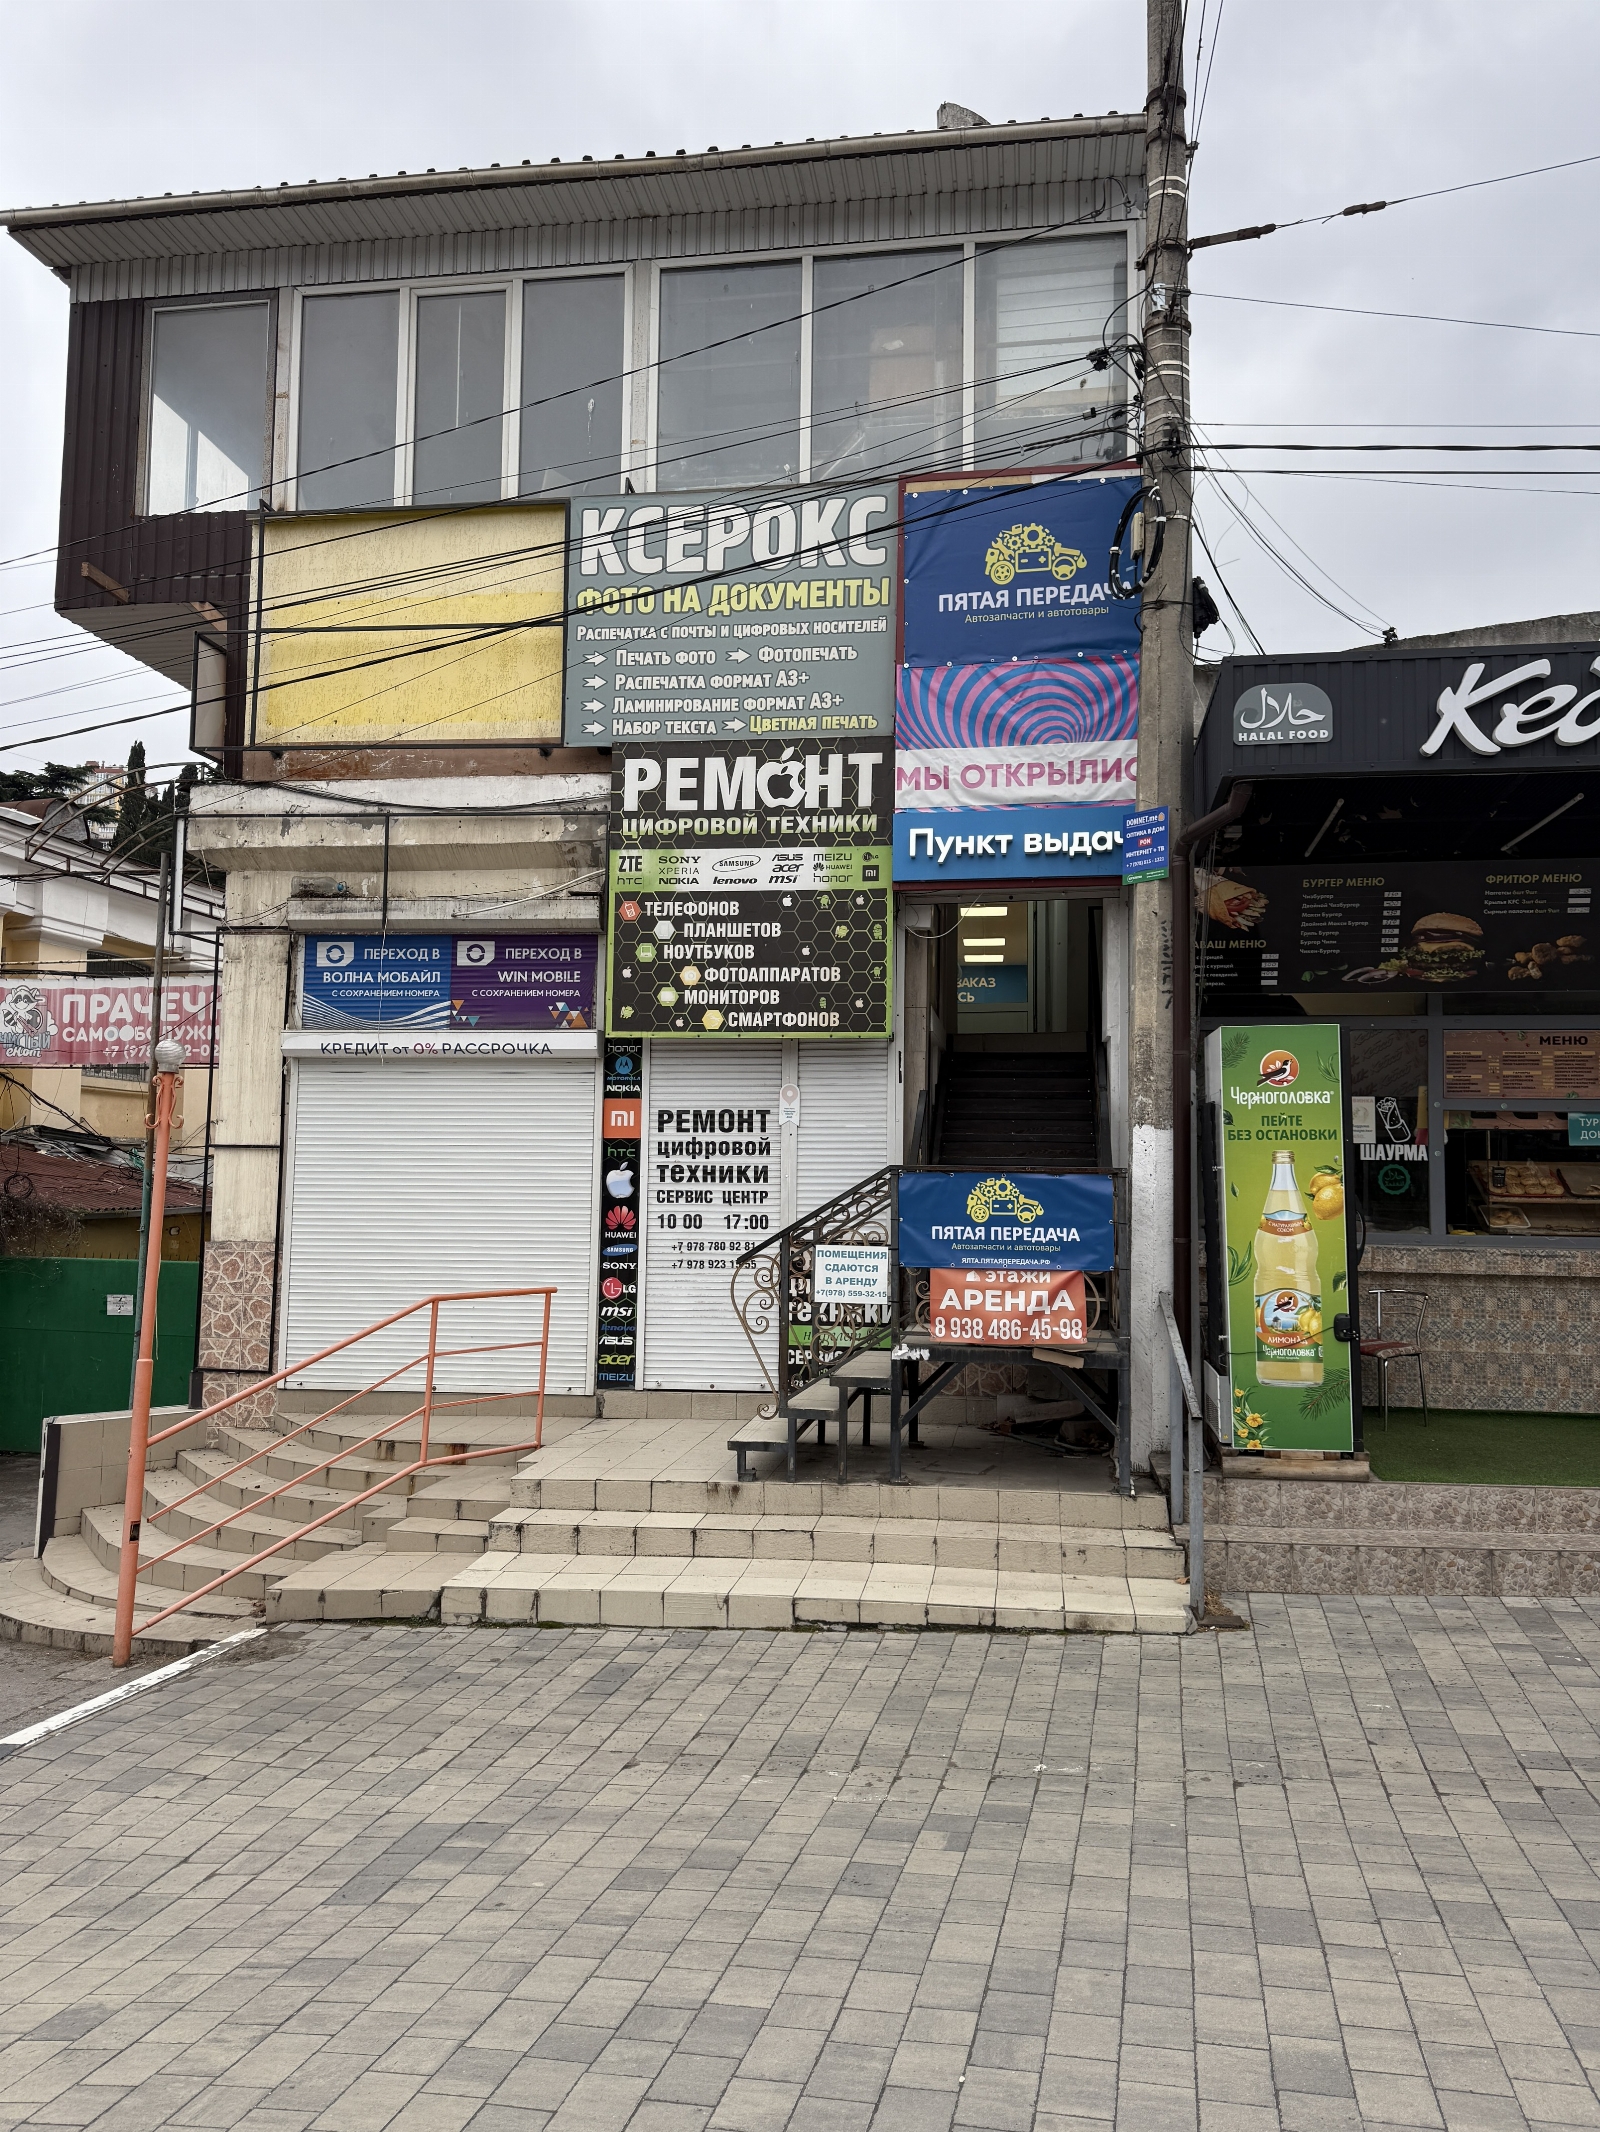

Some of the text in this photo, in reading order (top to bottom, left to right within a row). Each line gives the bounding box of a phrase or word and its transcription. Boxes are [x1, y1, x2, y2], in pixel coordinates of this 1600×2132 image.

[580, 496, 887, 575] КСЕРОКС
[577, 577, 889, 616] ФОТО НА ДОКУМЕНТЫ
[938, 589, 1009, 613] ПЯТАЯ
[965, 605, 1109, 623] Автозапчасти и автотовары
[577, 625, 657, 641] РАСПЕЧАТКА
[672, 625, 717, 638] ПОЧТЫ
[720, 625, 729, 637] И
[733, 621, 809, 639] ЦИФРОВЫХ
[813, 616, 887, 634] НОСИТЕЛЕЙ
[616, 645, 858, 666] ПЕЧАТЬ ФОТО ФОТОПЕЧАТЬ
[614, 673, 706, 691] РАСПЕЧАТКА
[710, 673, 771, 689] ФОРМАТ
[612, 697, 739, 714] ЛАМИНИРОВАНИЕ
[743, 696, 805, 712] ФОРМАТ
[1239, 688, 1326, 729] حلال
[612, 718, 717, 735] НАБОР ТЕКСТА
[749, 715, 879, 735] ЦВЕТНАЯ ПЕЧАТЬ
[1238, 728, 1330, 742] HALAL FOOD
[623, 751, 884, 812] РЕМОНТ
[896, 764, 950, 792] МЫ
[621, 813, 878, 838] ЦИФРОВОЙ ТЕХНИКИ
[910, 826, 1013, 864] Пункт
[658, 855, 702, 865] SONY
[719, 858, 754, 868] SAMSUNG
[771, 853, 804, 862] ASUS
[813, 852, 852, 862] MEIZU
[618, 855, 643, 873] ZTE
[772, 863, 803, 873] acer
[825, 863, 853, 871] HUAWEI
[658, 866, 700, 876] XPERIA
[813, 872, 853, 883] honor
[616, 875, 643, 886] htc
[658, 876, 700, 885] NOKIA
[712, 875, 758, 885] lenovo
[768, 875, 800, 884] msi
[1302, 877, 1385, 889] БУРГЕР МЕНЮ
[1485, 873, 1582, 884] ФРИТЮР МЕНЮ
[644, 900, 740, 917] ТЕЛЕФОНОВ
[683, 922, 782, 938] ПЛАНШЕТОВ
[1229, 939, 1267, 949] МЕНЮ
[364, 947, 440, 962] ПЕРЕХОД В
[505, 947, 582, 962] ПЕРЕХОД В
[663, 944, 755, 960] НОУТБУКОВ
[323, 968, 441, 984] ВОЛНА МОБАЙЛ
[497, 970, 581, 983] WIN MOBILE
[704, 966, 841, 983] ФОТОАППАРАТОВ
[339, 989, 405, 997] СОХРАНЕНИЕМ
[405, 989, 440, 997] НОМЕРА
[480, 989, 545, 997] СОХРАНЕНИЕМ
[545, 989, 581, 997] НОМЕРА
[683, 989, 780, 1005] МОНИТОРОВ
[957, 991, 975, 1003] СЬ
[727, 1011, 841, 1028] СМАРТФОНОВ
[1539, 1035, 1588, 1046] МЕНЮ
[320, 1042, 553, 1056] КРЕДИТ от 0% РАССРОЧКА
[608, 1043, 641, 1053] honor
[606, 1084, 641, 1092] NOKIA
[657, 1109, 771, 1134] РЕМОНТ
[1261, 1112, 1303, 1126] ПЕЙТЕ
[1227, 1129, 1337, 1141] БЕЗ ОСТАНОВКИ
[608, 1147, 636, 1157] htc
[657, 1136, 771, 1161] цифровой
[1359, 1143, 1429, 1161] ШАУРМА
[656, 1163, 769, 1184] техники
[656, 1189, 769, 1207] СЕРВИС ЦЕНТР
[657, 1213, 678, 1229] 10
[682, 1213, 703, 1229] 00
[605, 1231, 637, 1239] HUAWEI
[931, 1225, 1080, 1244] ПЯТАЯ ПЕРЕДАЧА
[671, 1241, 756, 1251] +7 978 780 92 81
[951, 1241, 1002, 1252] Автозапчасти
[1014, 1243, 1061, 1253] автотовары
[817, 1249, 888, 1261] ПОМЕЩЕНИЯ
[602, 1262, 637, 1270] SONY
[671, 1260, 684, 1269] +7
[687, 1260, 705, 1269] 978
[708, 1260, 726, 1269] 923
[824, 1262, 879, 1275] СДАЮТСЯ
[826, 1275, 878, 1288] В АРЕНДУ
[985, 1270, 1051, 1284] этажи
[816, 1289, 846, 1300] +7(978)
[939, 1288, 1076, 1316] АРЕНДА
[600, 1306, 633, 1317] msi
[600, 1323, 636, 1332] lenovo
[935, 1317, 1083, 1341] 8 938 486-45-98
[598, 1336, 634, 1346] ASUS
[598, 1354, 636, 1366] acer
[598, 1373, 634, 1382] MEIZU
